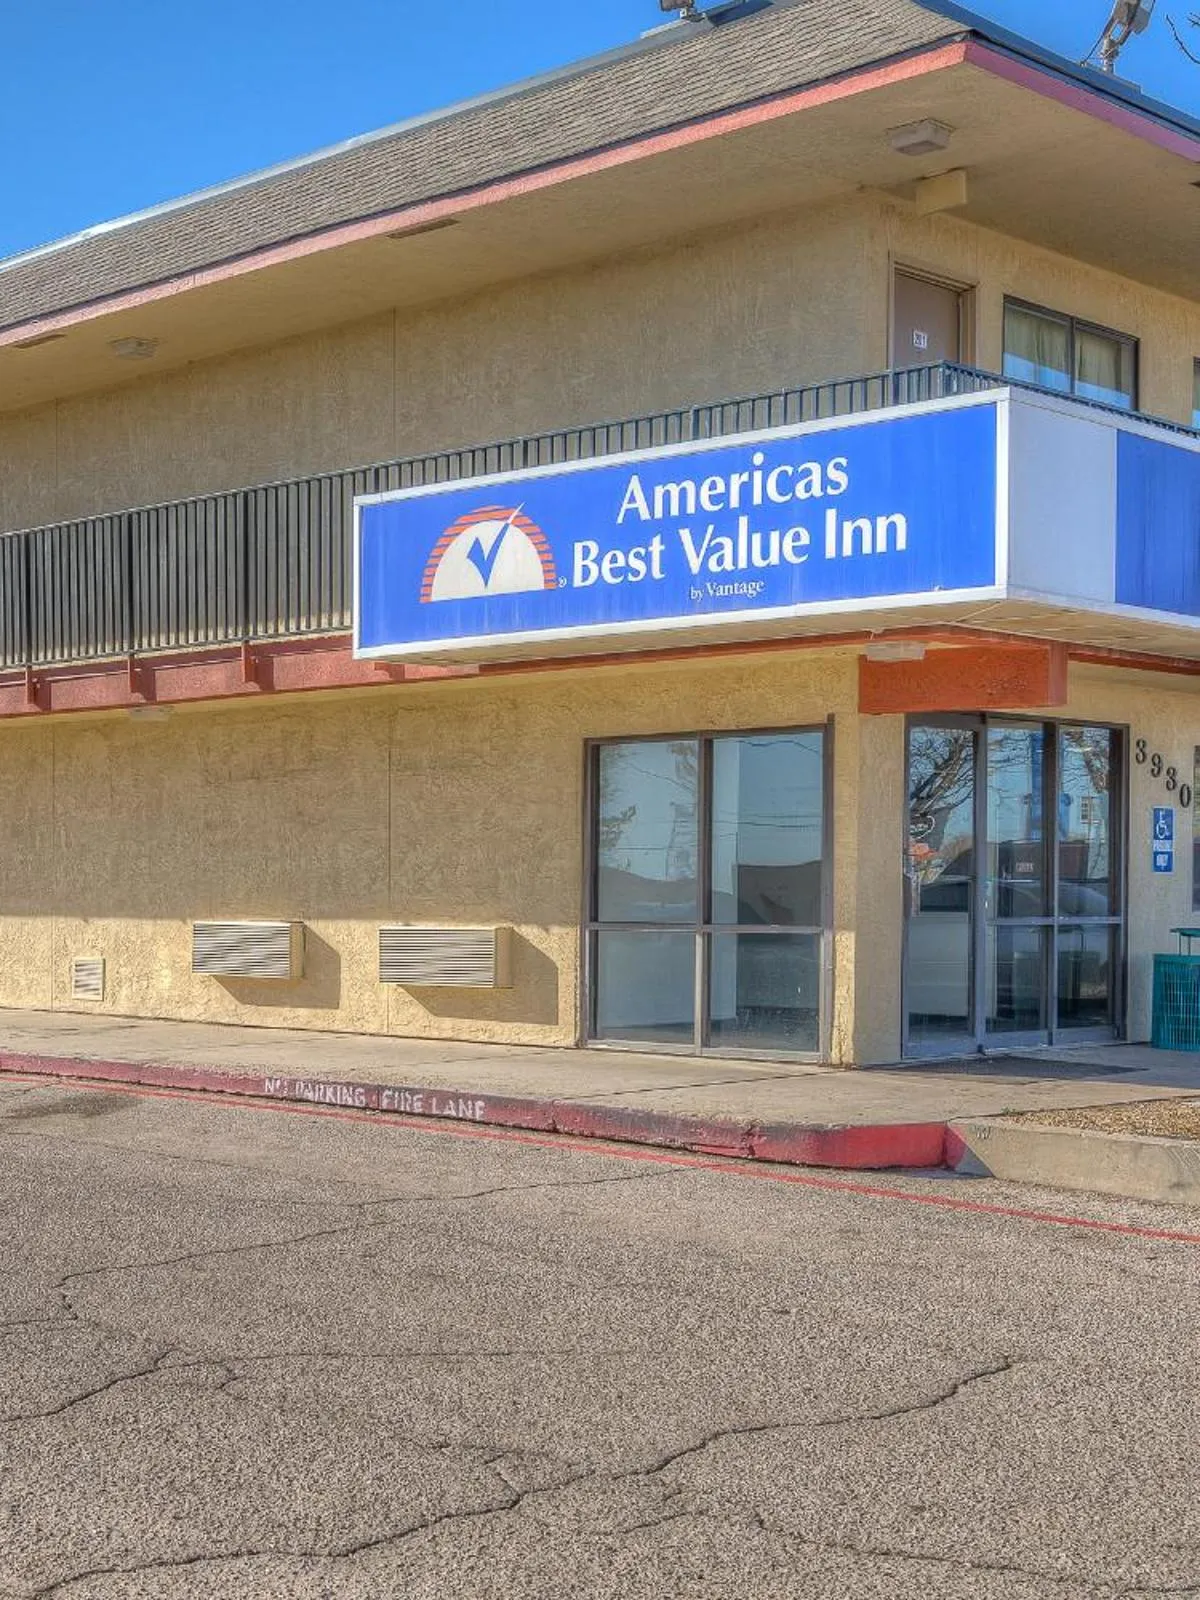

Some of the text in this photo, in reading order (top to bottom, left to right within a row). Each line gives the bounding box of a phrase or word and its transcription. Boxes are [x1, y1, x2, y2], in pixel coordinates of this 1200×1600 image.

[616, 452, 849, 525] Americas
[572, 508, 908, 588] Best Value Inn
[690, 580, 766, 602] by Vantage
[1135, 738, 1192, 809] 3930
[296, 1081, 366, 1107] PARKING
[382, 1088, 424, 1112] FIRE
